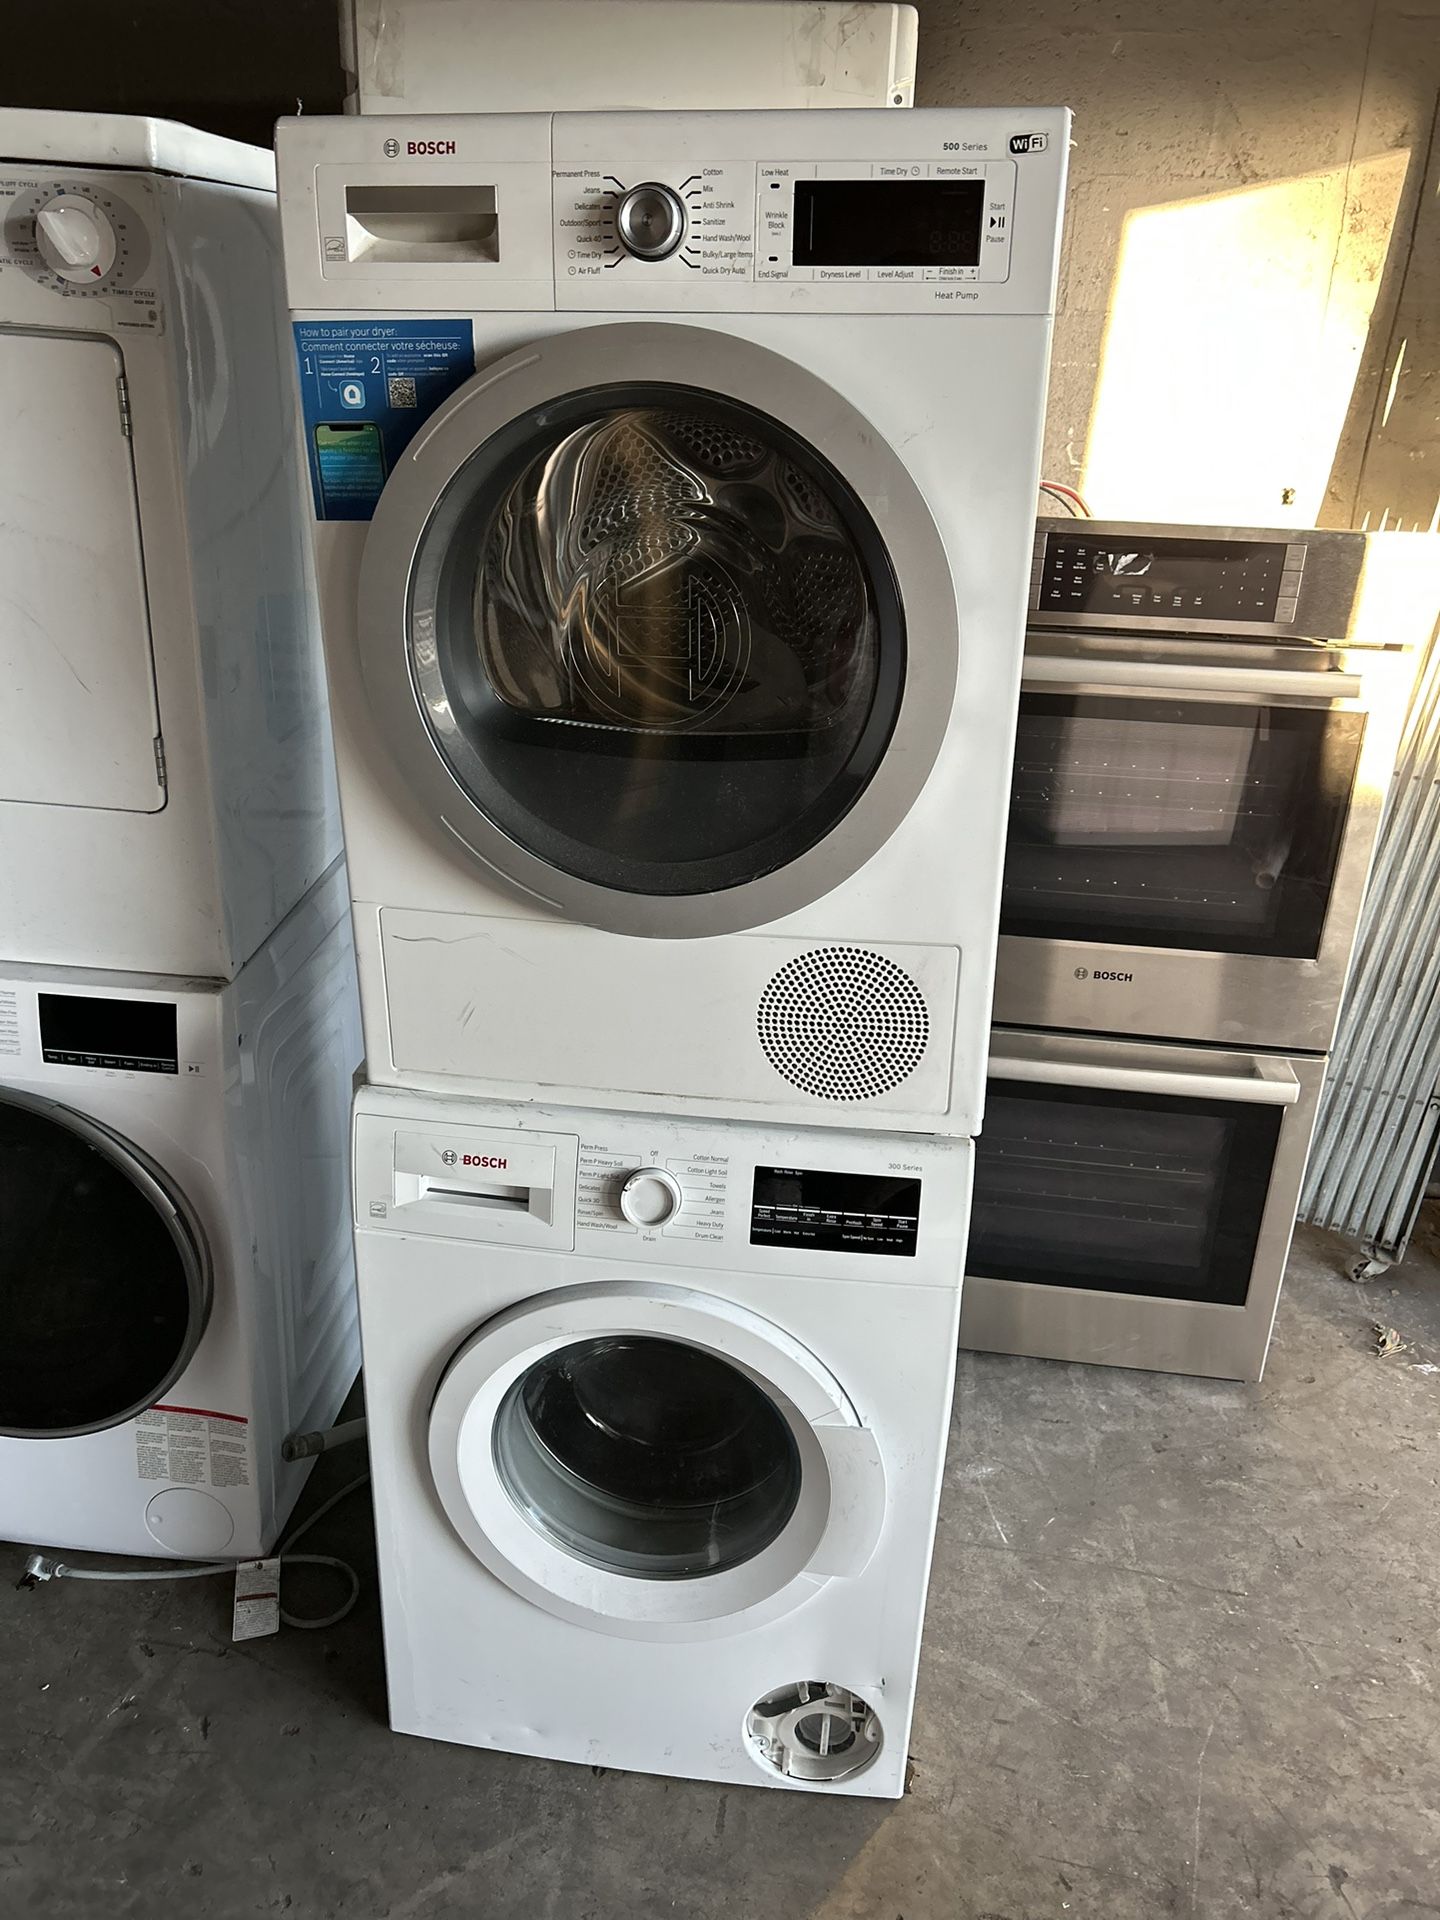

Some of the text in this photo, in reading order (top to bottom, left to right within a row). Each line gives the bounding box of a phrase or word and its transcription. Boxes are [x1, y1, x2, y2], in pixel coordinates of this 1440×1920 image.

[407, 141, 456, 155] BOSCH
[943, 142, 988, 151] 500 Series
[703, 168, 723, 176] Cotton
[880, 167, 908, 176] Time Dry
[937, 167, 977, 175] Remote Start
[716, 201, 735, 209] Shrink
[989, 203, 1005, 211] Start
[703, 218, 726, 226] Sanitize
[768, 221, 785, 229] Block
[576, 235, 592, 243] Quick
[986, 235, 1005, 243] Pause
[592, 251, 601, 260] Dry
[720, 266, 731, 275] Dry
[877, 270, 914, 279] Level Adjust
[770, 271, 788, 279] Signal
[820, 271, 844, 279] Dryness
[935, 291, 979, 301] Heat Pump
[300, 326, 398, 339] How to pair your dryer:
[301, 340, 461, 352] Comment connecter votre sécheuse:
[304, 356, 381, 375] 1 2
[1093, 971, 1133, 982] BOSCH
[463, 1154, 507, 1169] BOSCH
[705, 1168, 717, 1176] Light
[705, 1196, 725, 1204] Allergen
[696, 1220, 711, 1228] Heavy
